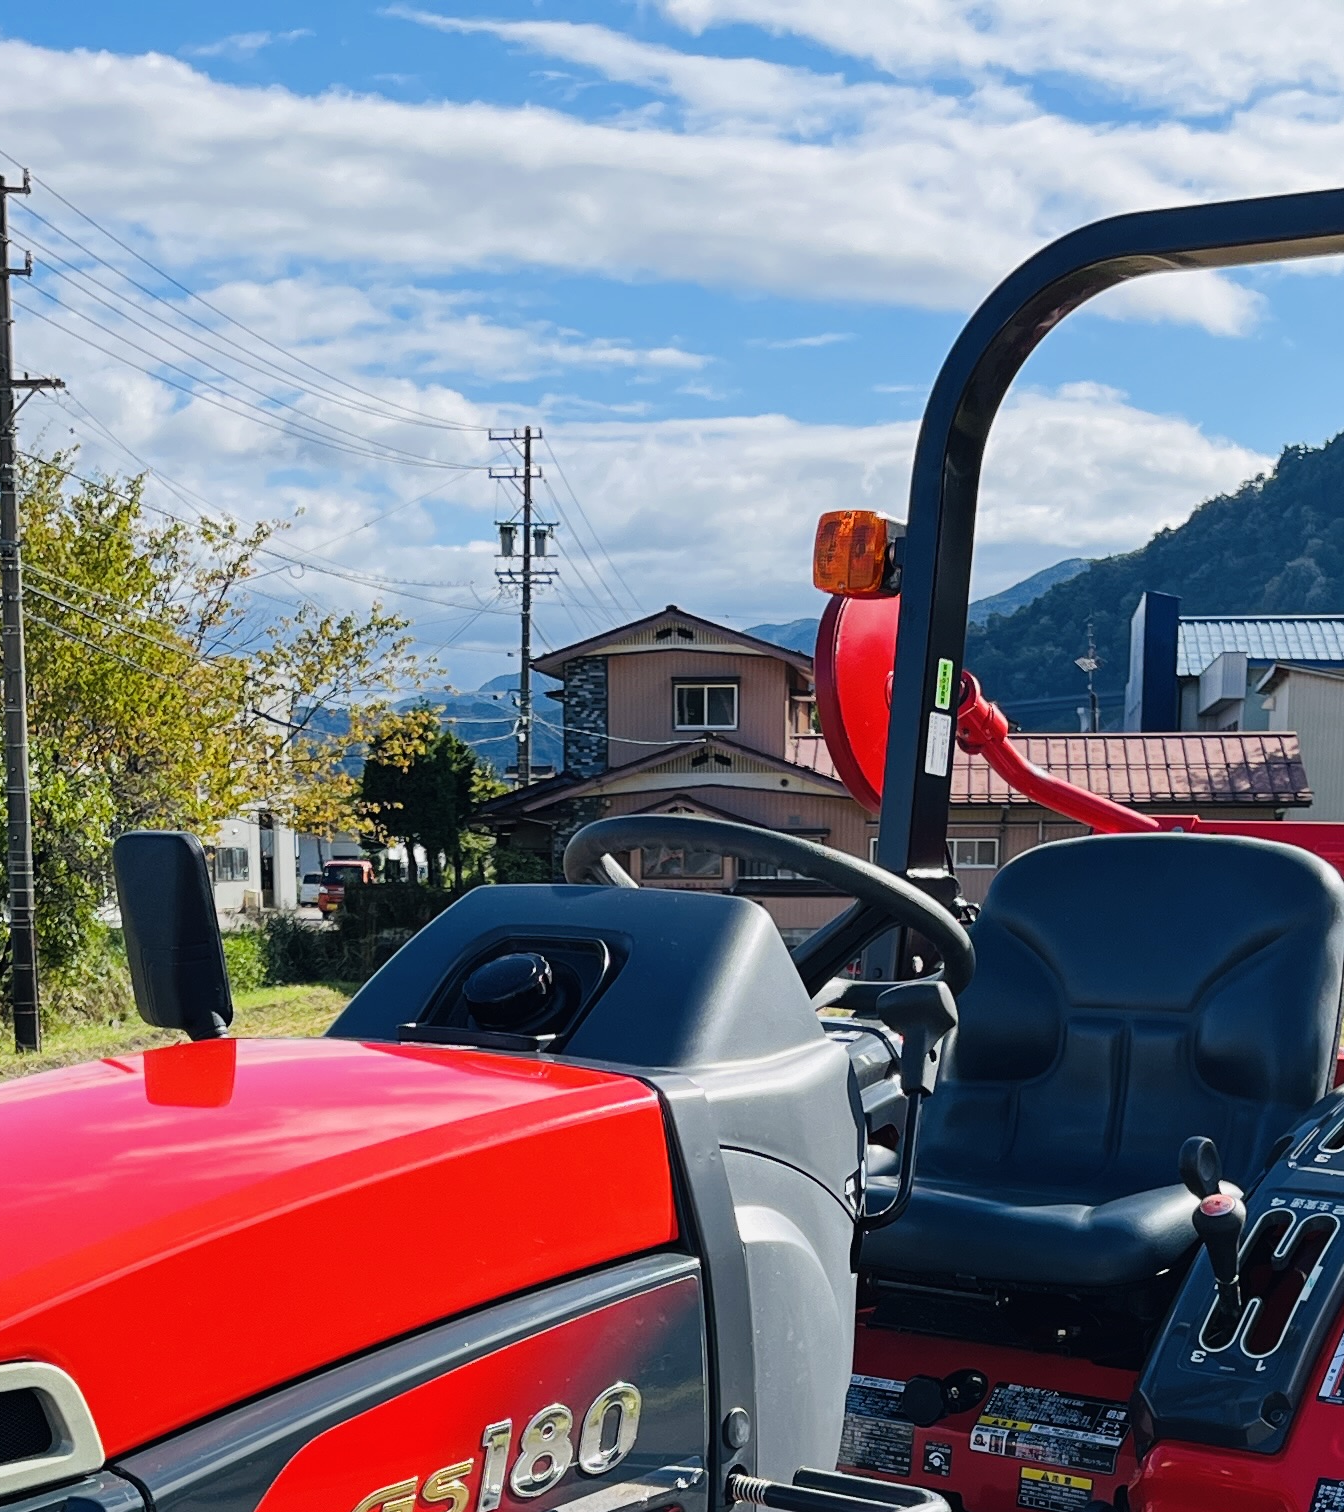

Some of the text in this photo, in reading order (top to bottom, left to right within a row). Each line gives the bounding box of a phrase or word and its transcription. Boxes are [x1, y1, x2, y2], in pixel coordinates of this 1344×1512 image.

[1313, 1153, 1332, 1163] 3
[1270, 1197, 1287, 1208] 4
[1190, 1350, 1207, 1364] 3
[1255, 1359, 1267, 1372] 1
